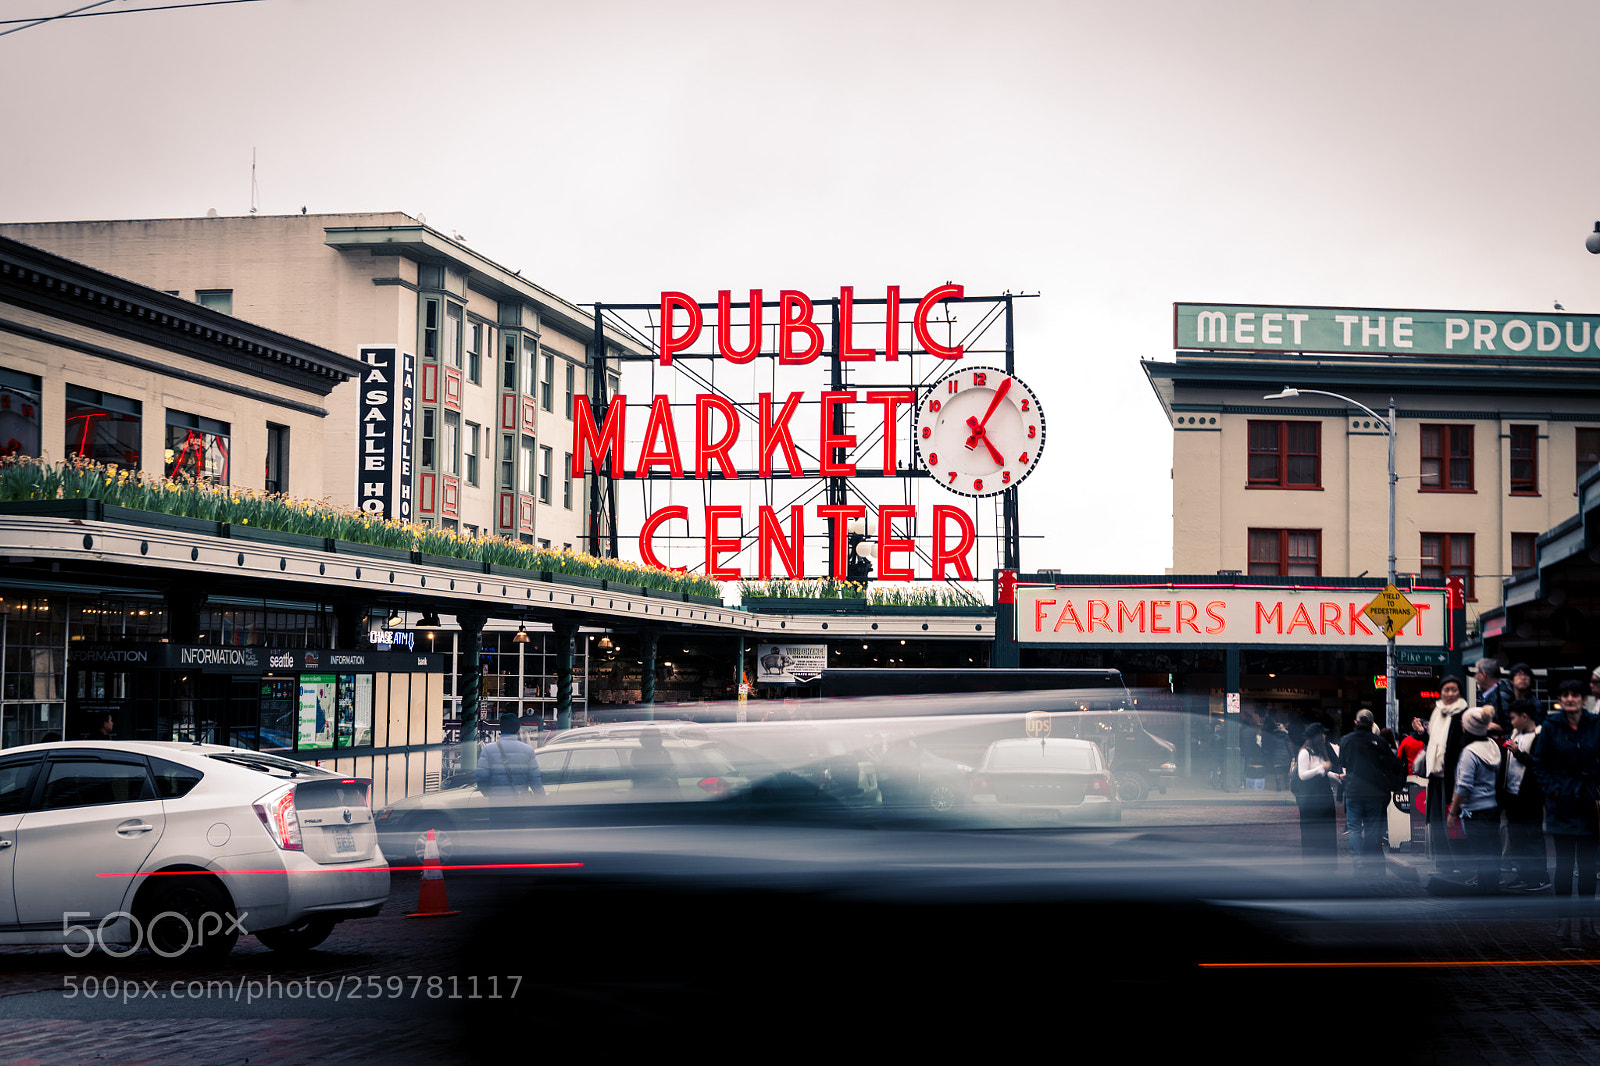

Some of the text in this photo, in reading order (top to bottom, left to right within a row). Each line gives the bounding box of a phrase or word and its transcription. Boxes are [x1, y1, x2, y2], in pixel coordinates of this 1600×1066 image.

[659, 284, 965, 366] PUBLIC
[1197, 310, 1600, 352] MEET THE PRODU
[364, 353, 388, 383] LA
[403, 356, 413, 389] LA
[948, 380, 958, 393] 11
[973, 373, 987, 386] 12
[929, 400, 941, 412] 10
[1021, 399, 1030, 412] 2
[363, 390, 388, 471] SALLE
[402, 397, 412, 476] SALLE
[571, 390, 915, 479] MARKET
[922, 426, 931, 439] 9
[1027, 425, 1036, 439] 3
[928, 452, 938, 465] 8
[1019, 451, 1029, 464] 4
[948, 471, 958, 484] 7
[1002, 471, 1011, 483] 5
[973, 478, 983, 491] 6
[639, 504, 976, 581] CENTER
[1034, 598, 1431, 636] FARMERS MARKT
[1370, 607, 1410, 615] PEDESTRIANS
[369, 630, 408, 645] CHASE ATM
[181, 648, 245, 664] INFORMATION
[269, 651, 294, 668] seattle
[330, 655, 365, 665] INFORMATION
[1400, 652, 1421, 662] Pike
[1027, 720, 1050, 737] ups
